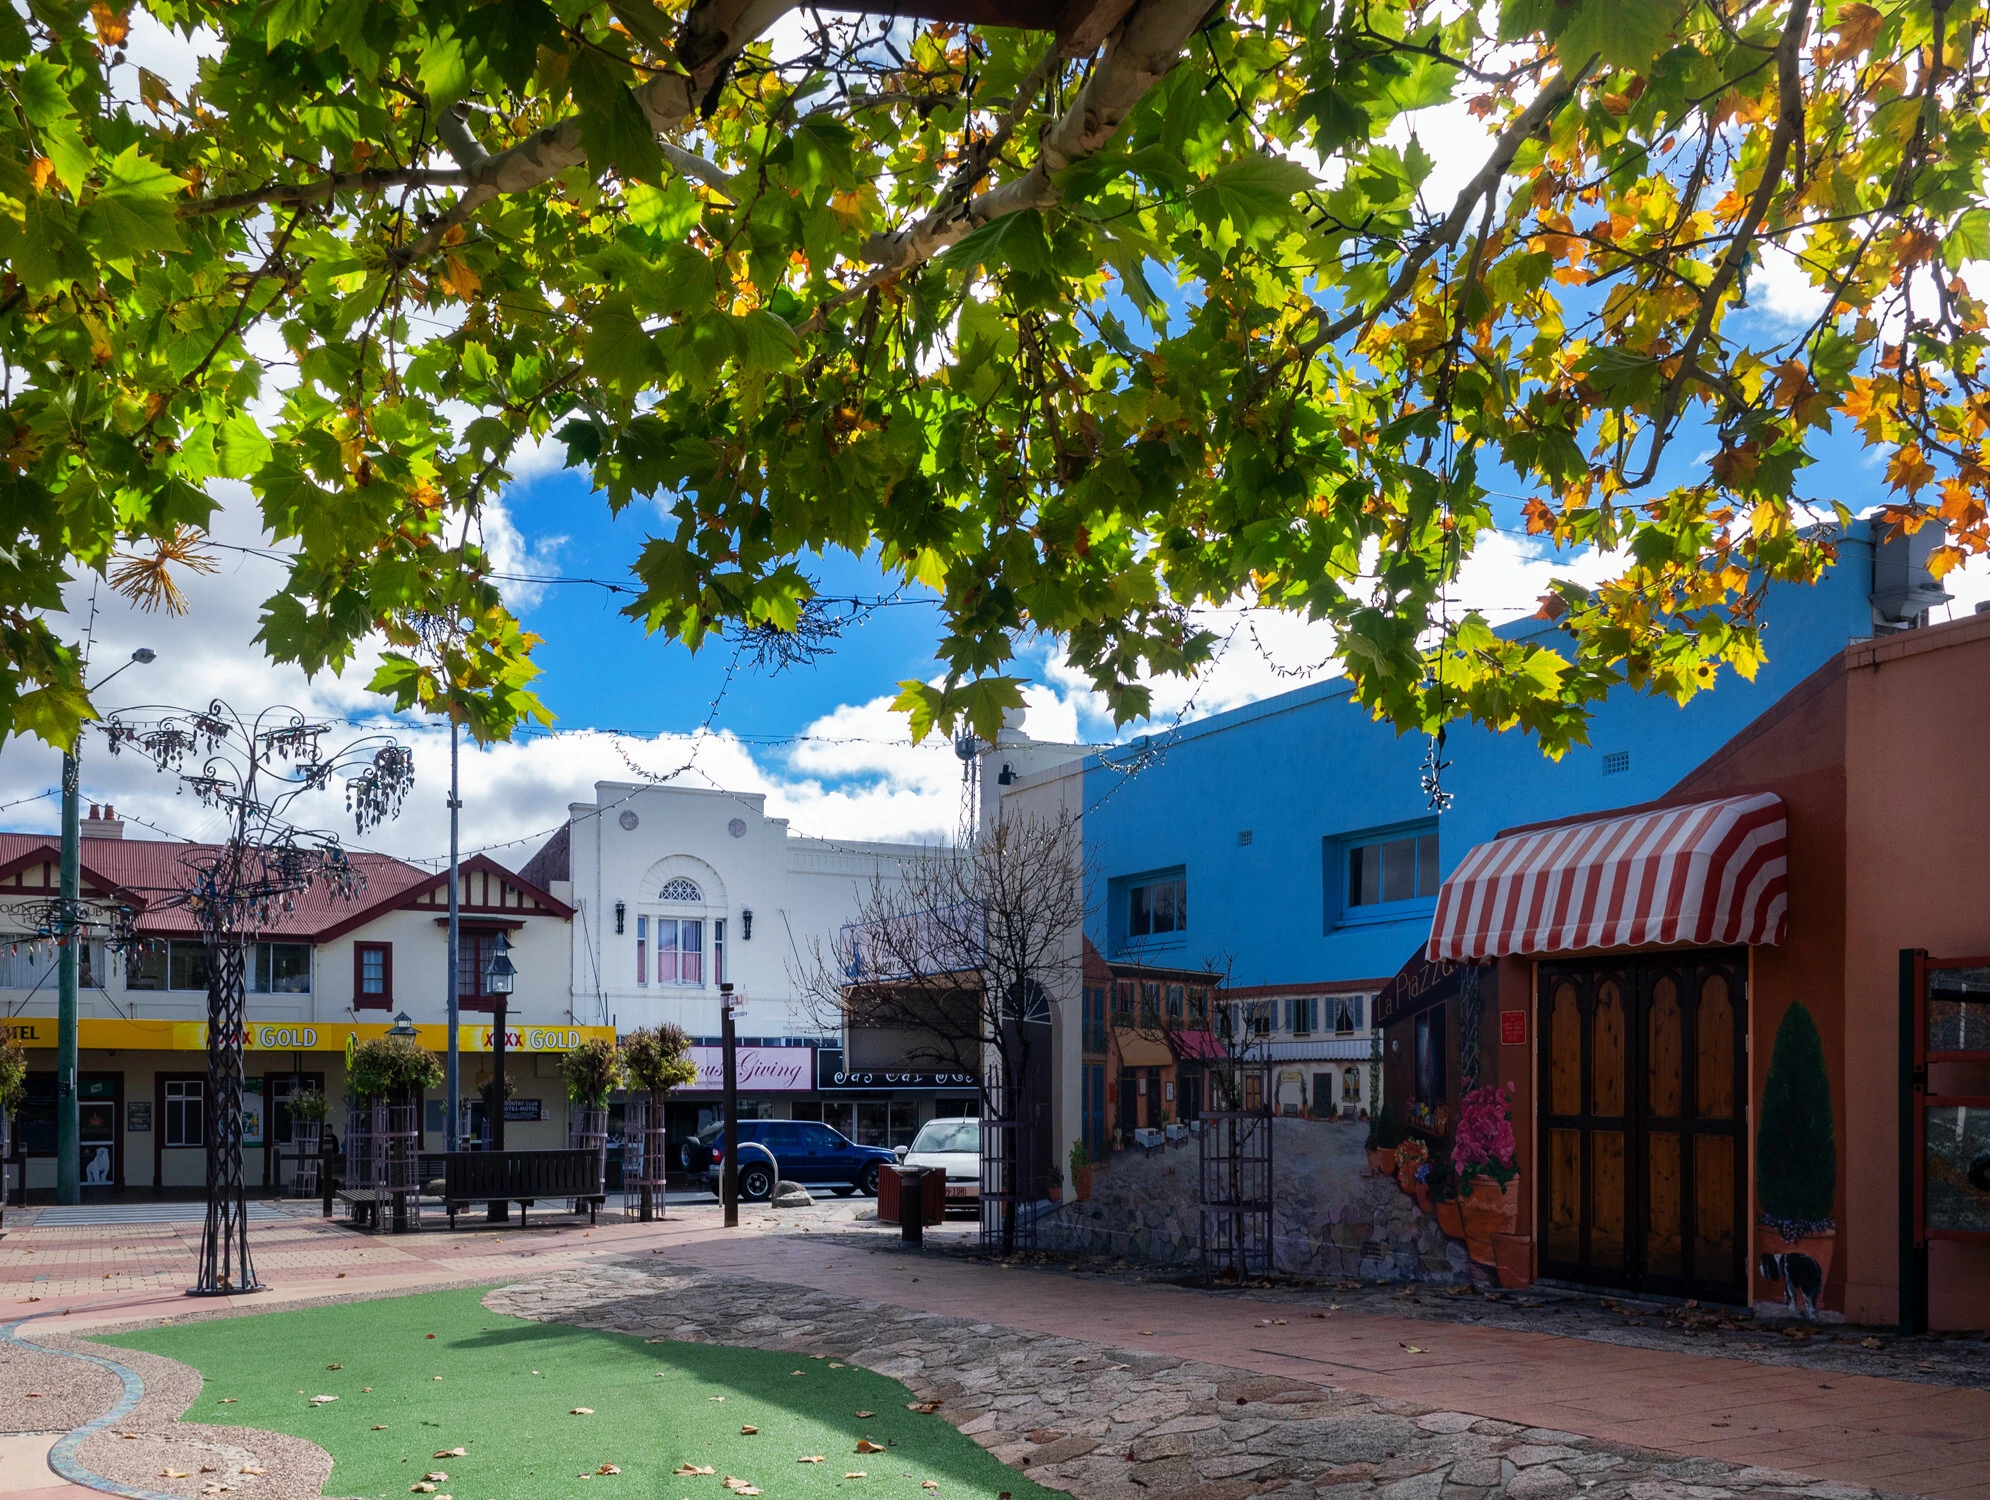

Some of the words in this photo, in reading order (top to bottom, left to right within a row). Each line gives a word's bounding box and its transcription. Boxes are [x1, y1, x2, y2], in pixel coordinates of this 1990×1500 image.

[1377, 997, 1393, 1022] La
[260, 1026, 318, 1048] GOLD
[483, 1032, 523, 1046] XXX
[530, 1029, 580, 1049] GOLD
[736, 1049, 804, 1088] Giving
